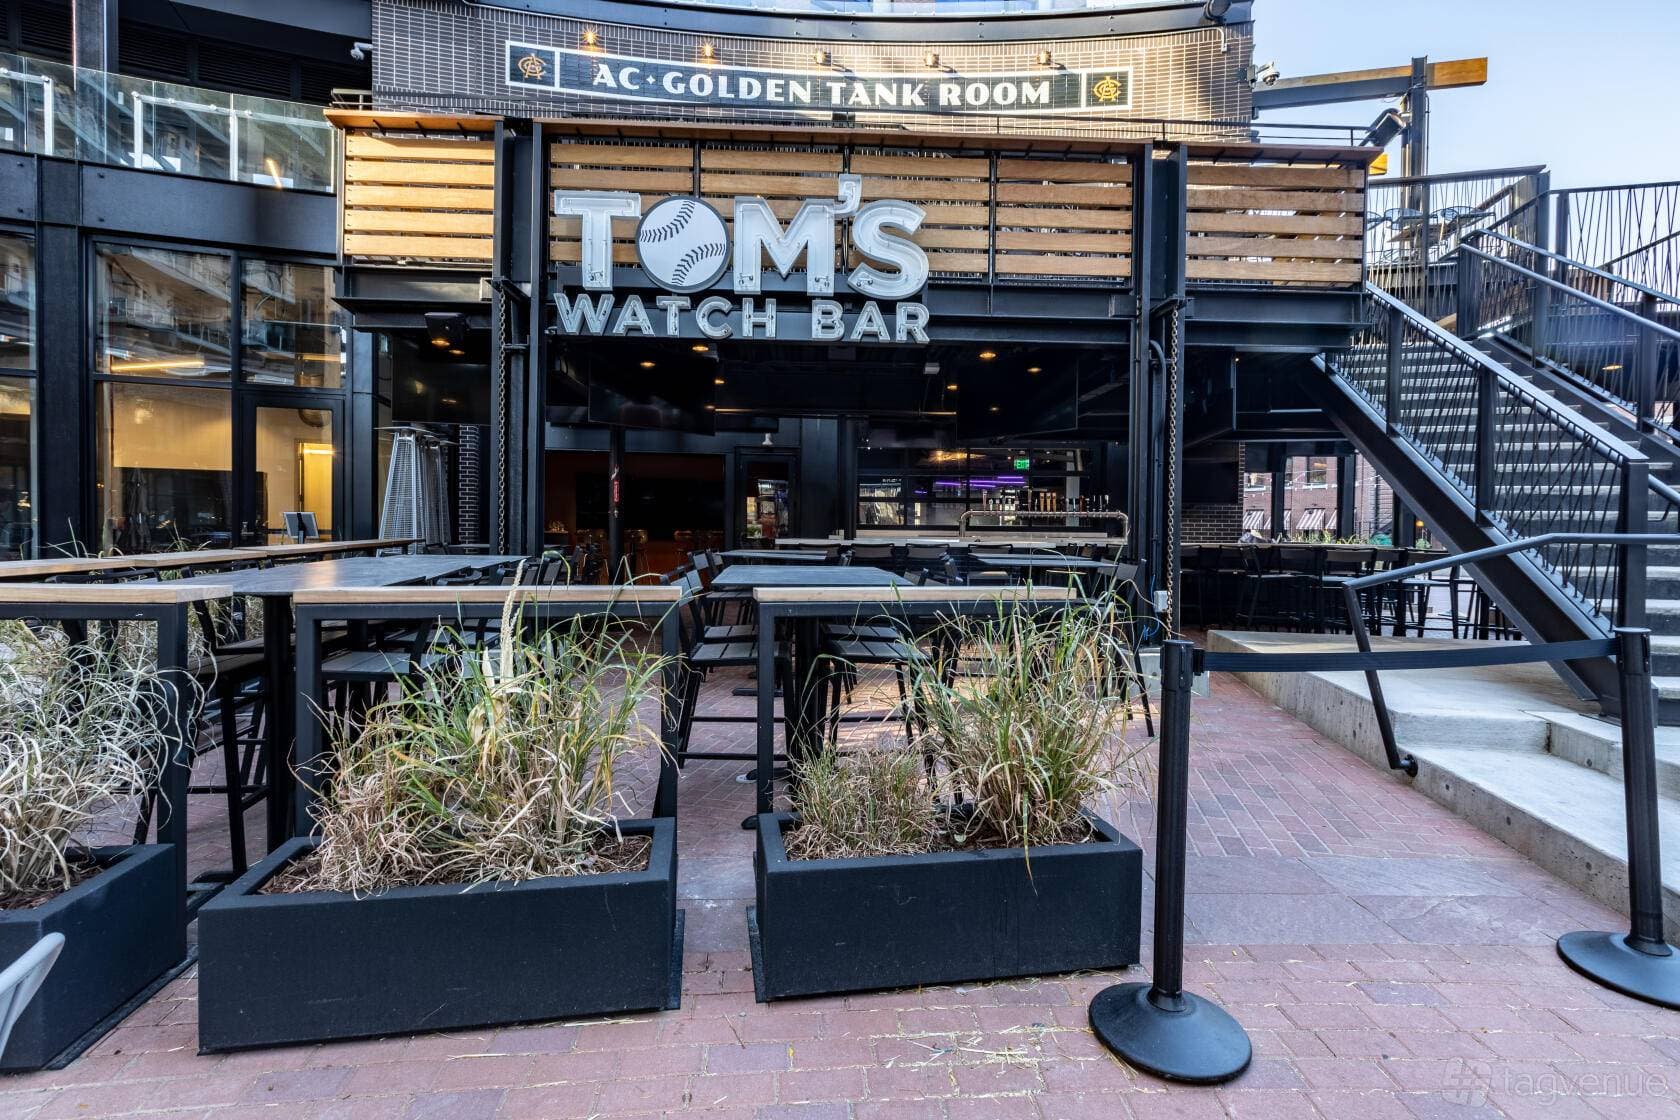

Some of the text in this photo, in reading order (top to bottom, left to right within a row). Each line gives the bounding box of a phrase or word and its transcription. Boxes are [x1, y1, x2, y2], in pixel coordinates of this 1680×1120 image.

[593, 63, 1050, 106] AC GOLDEN TANK ROOM
[553, 292, 931, 344] WATCH BAR
